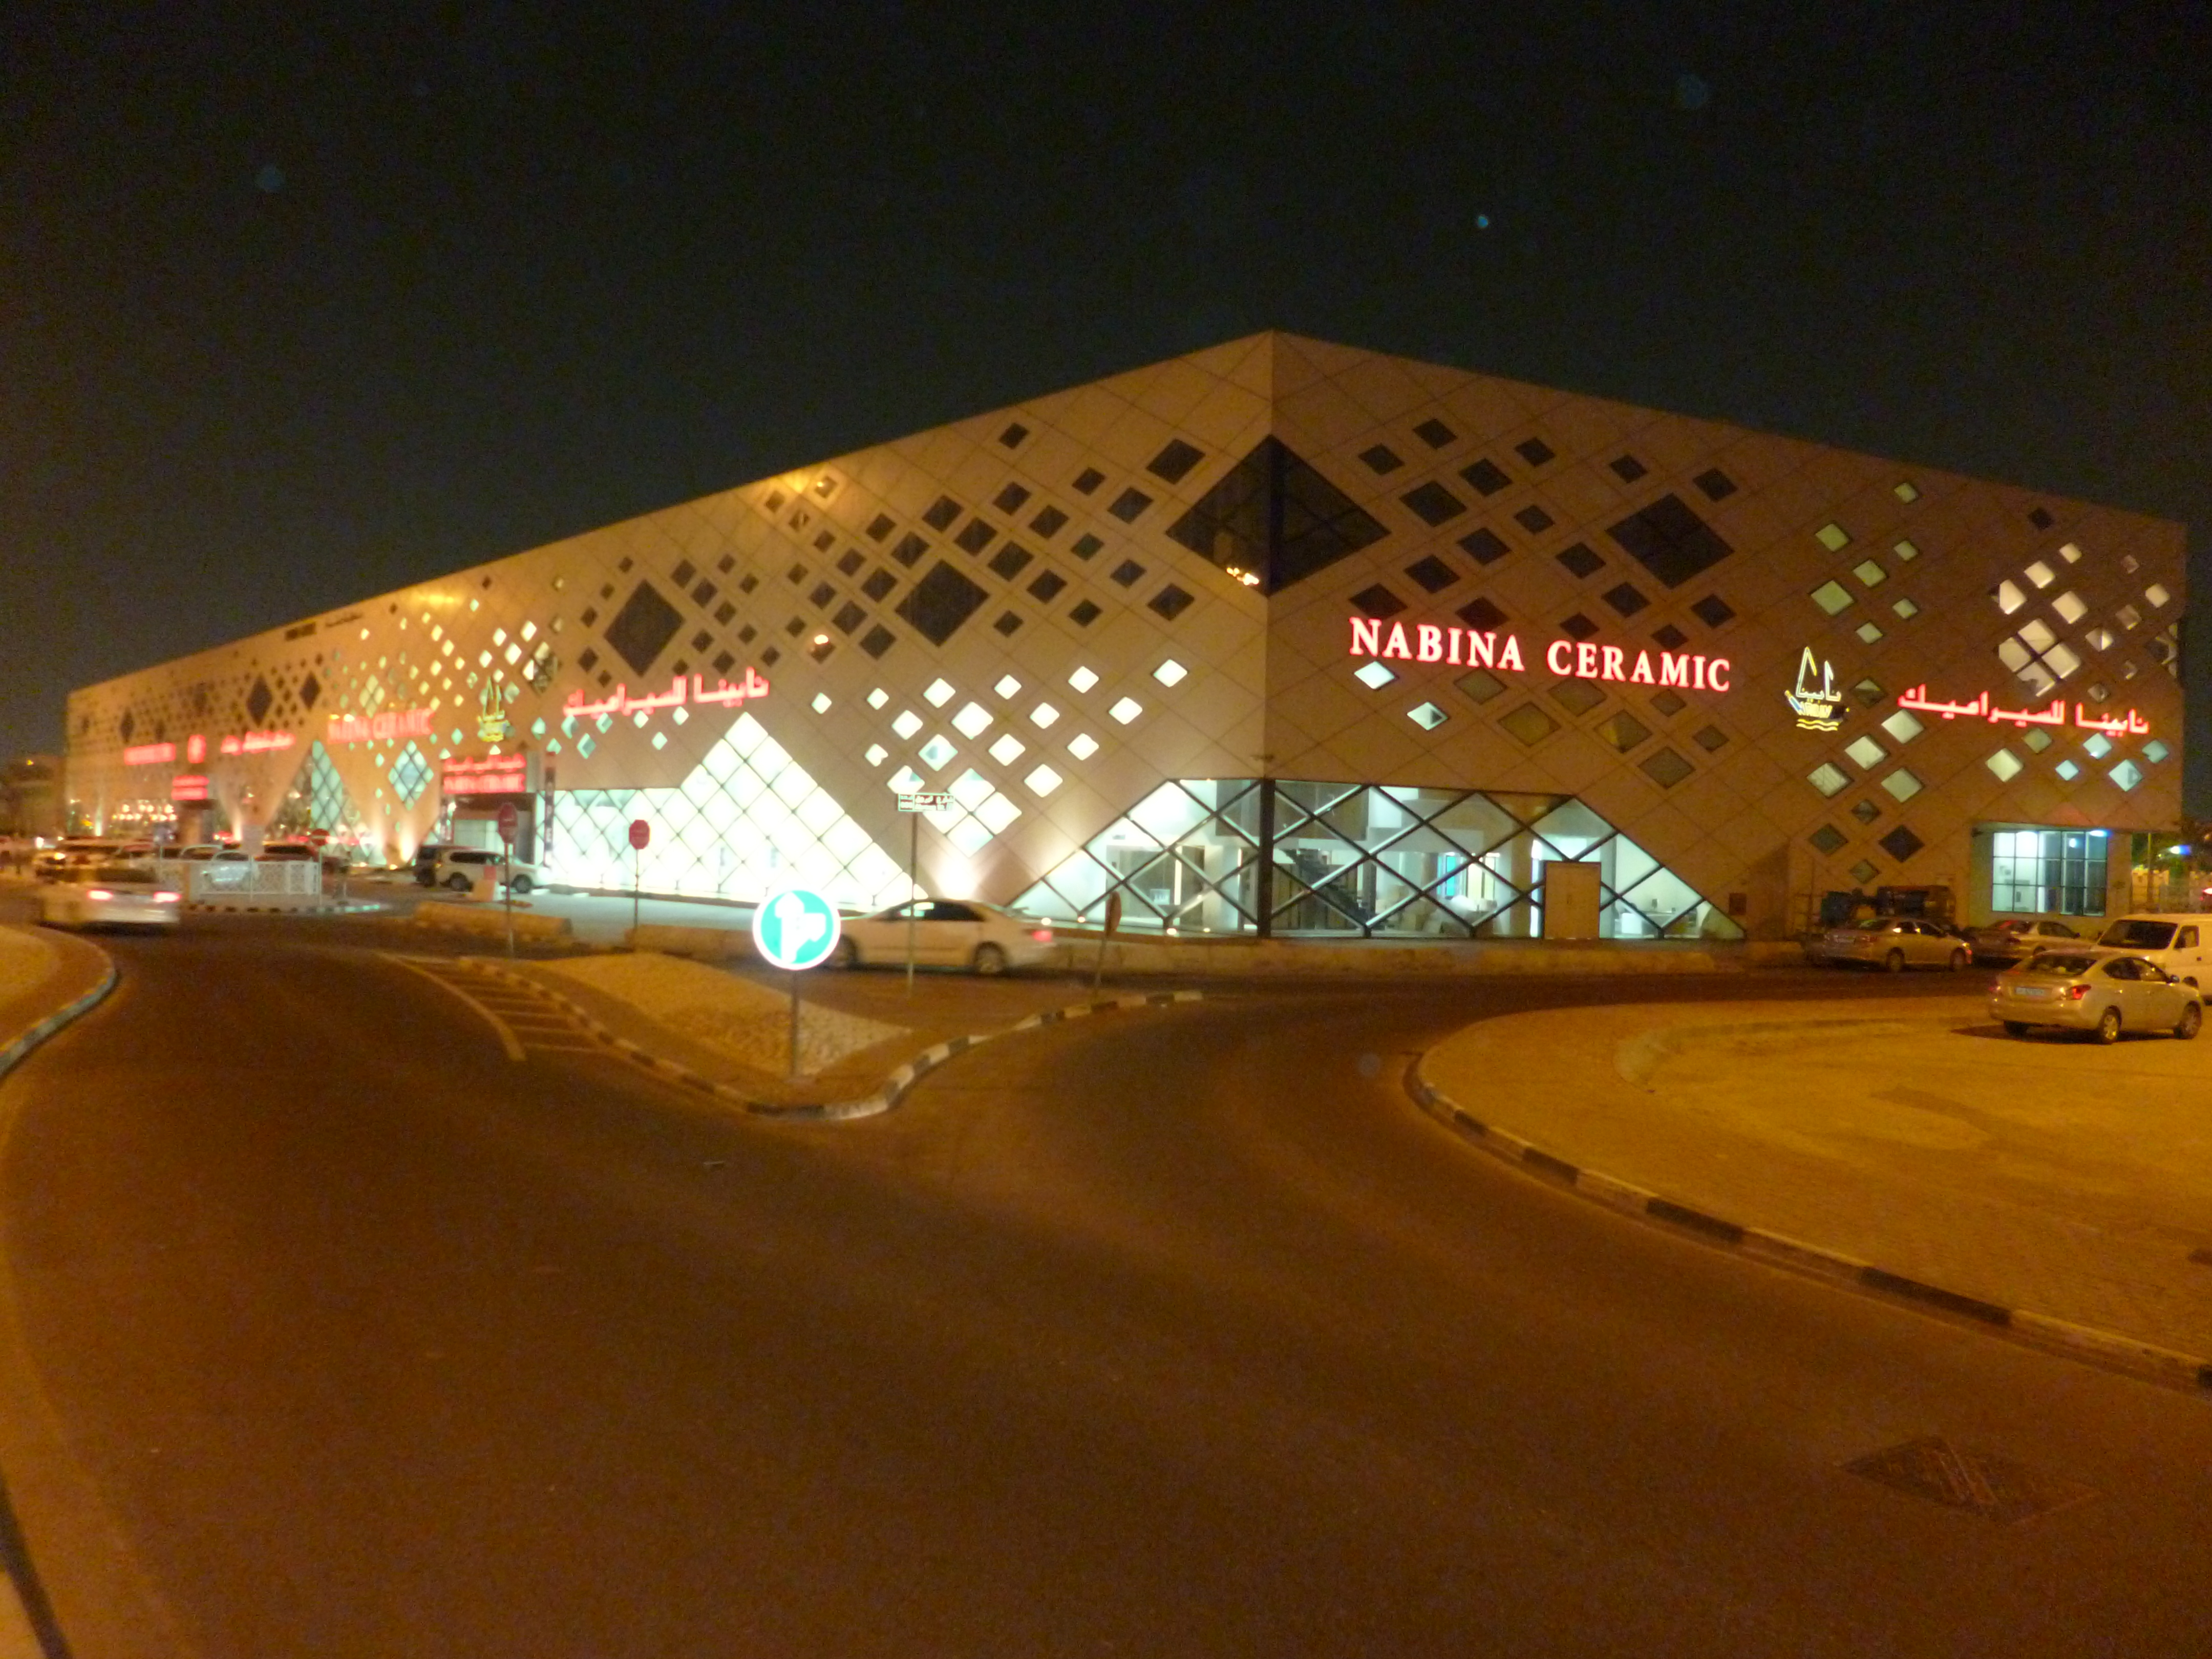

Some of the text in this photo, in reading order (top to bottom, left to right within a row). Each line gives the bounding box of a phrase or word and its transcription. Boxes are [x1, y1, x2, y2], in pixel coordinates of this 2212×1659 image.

[1349, 616, 1730, 692] NABINA CERAMIC
[693, 666, 769, 708] نابينا
[1897, 684, 2149, 737] نابينا للسيراميك
